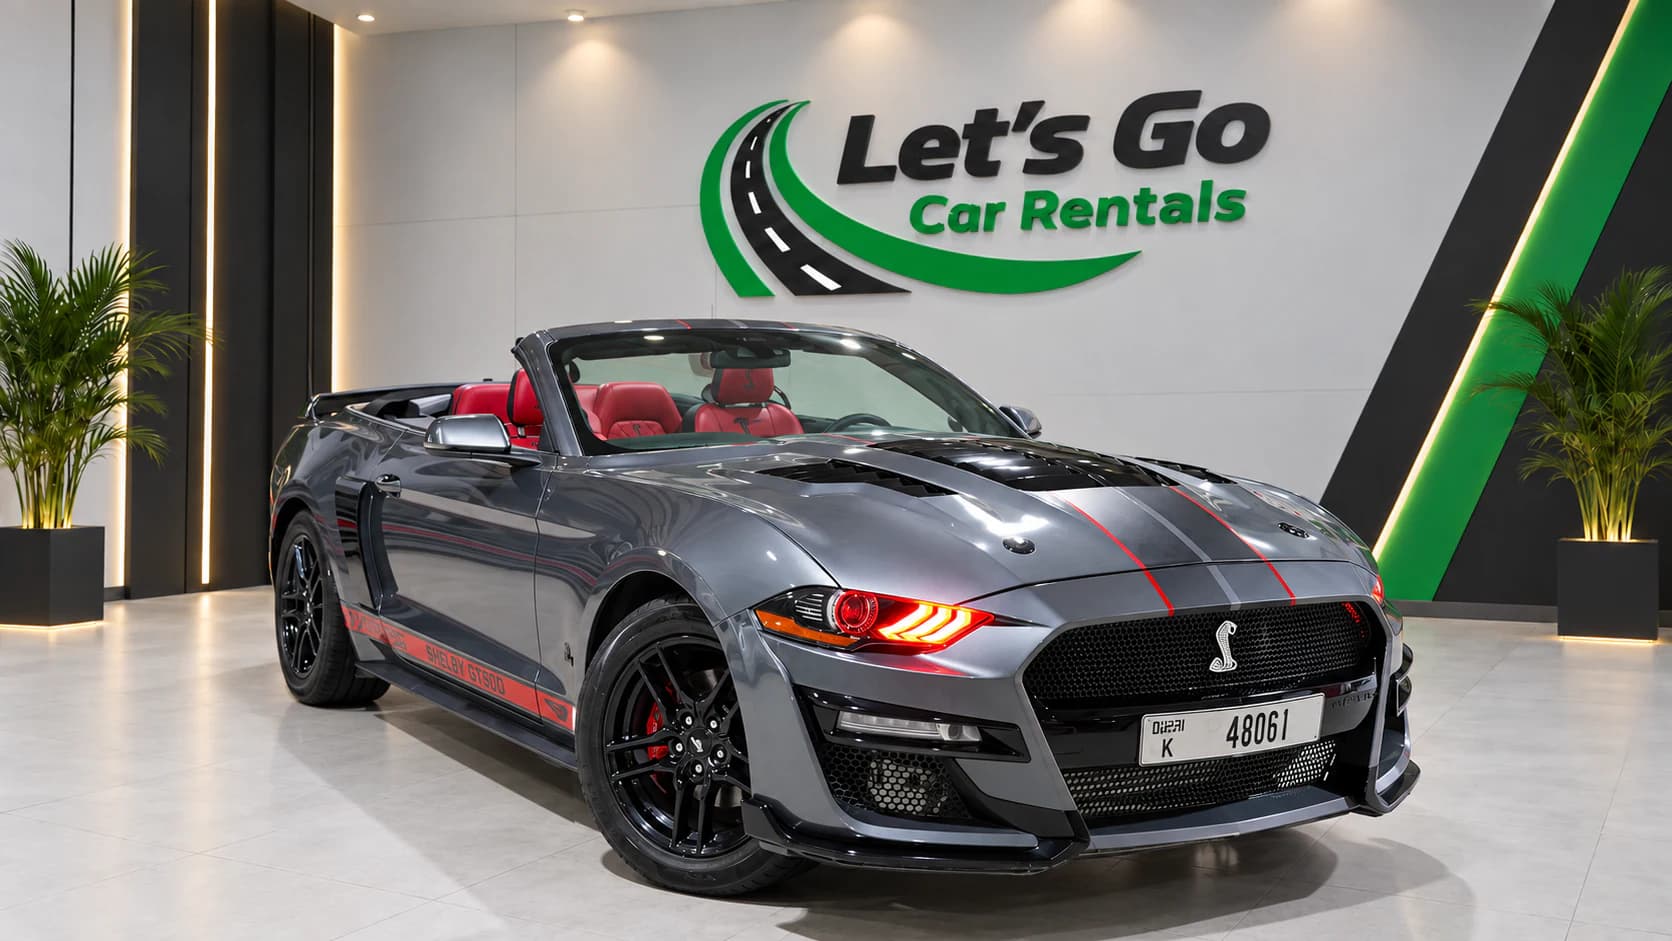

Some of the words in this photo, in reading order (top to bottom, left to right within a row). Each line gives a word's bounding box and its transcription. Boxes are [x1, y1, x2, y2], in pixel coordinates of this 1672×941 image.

[837, 100, 1090, 185] Let's
[1113, 89, 1271, 170] Go
[909, 194, 1006, 235] Car
[1020, 179, 1247, 231] Rentals
[425, 645, 465, 676] SHELBY
[1161, 738, 1174, 758] K
[1226, 708, 1289, 749] 48061
